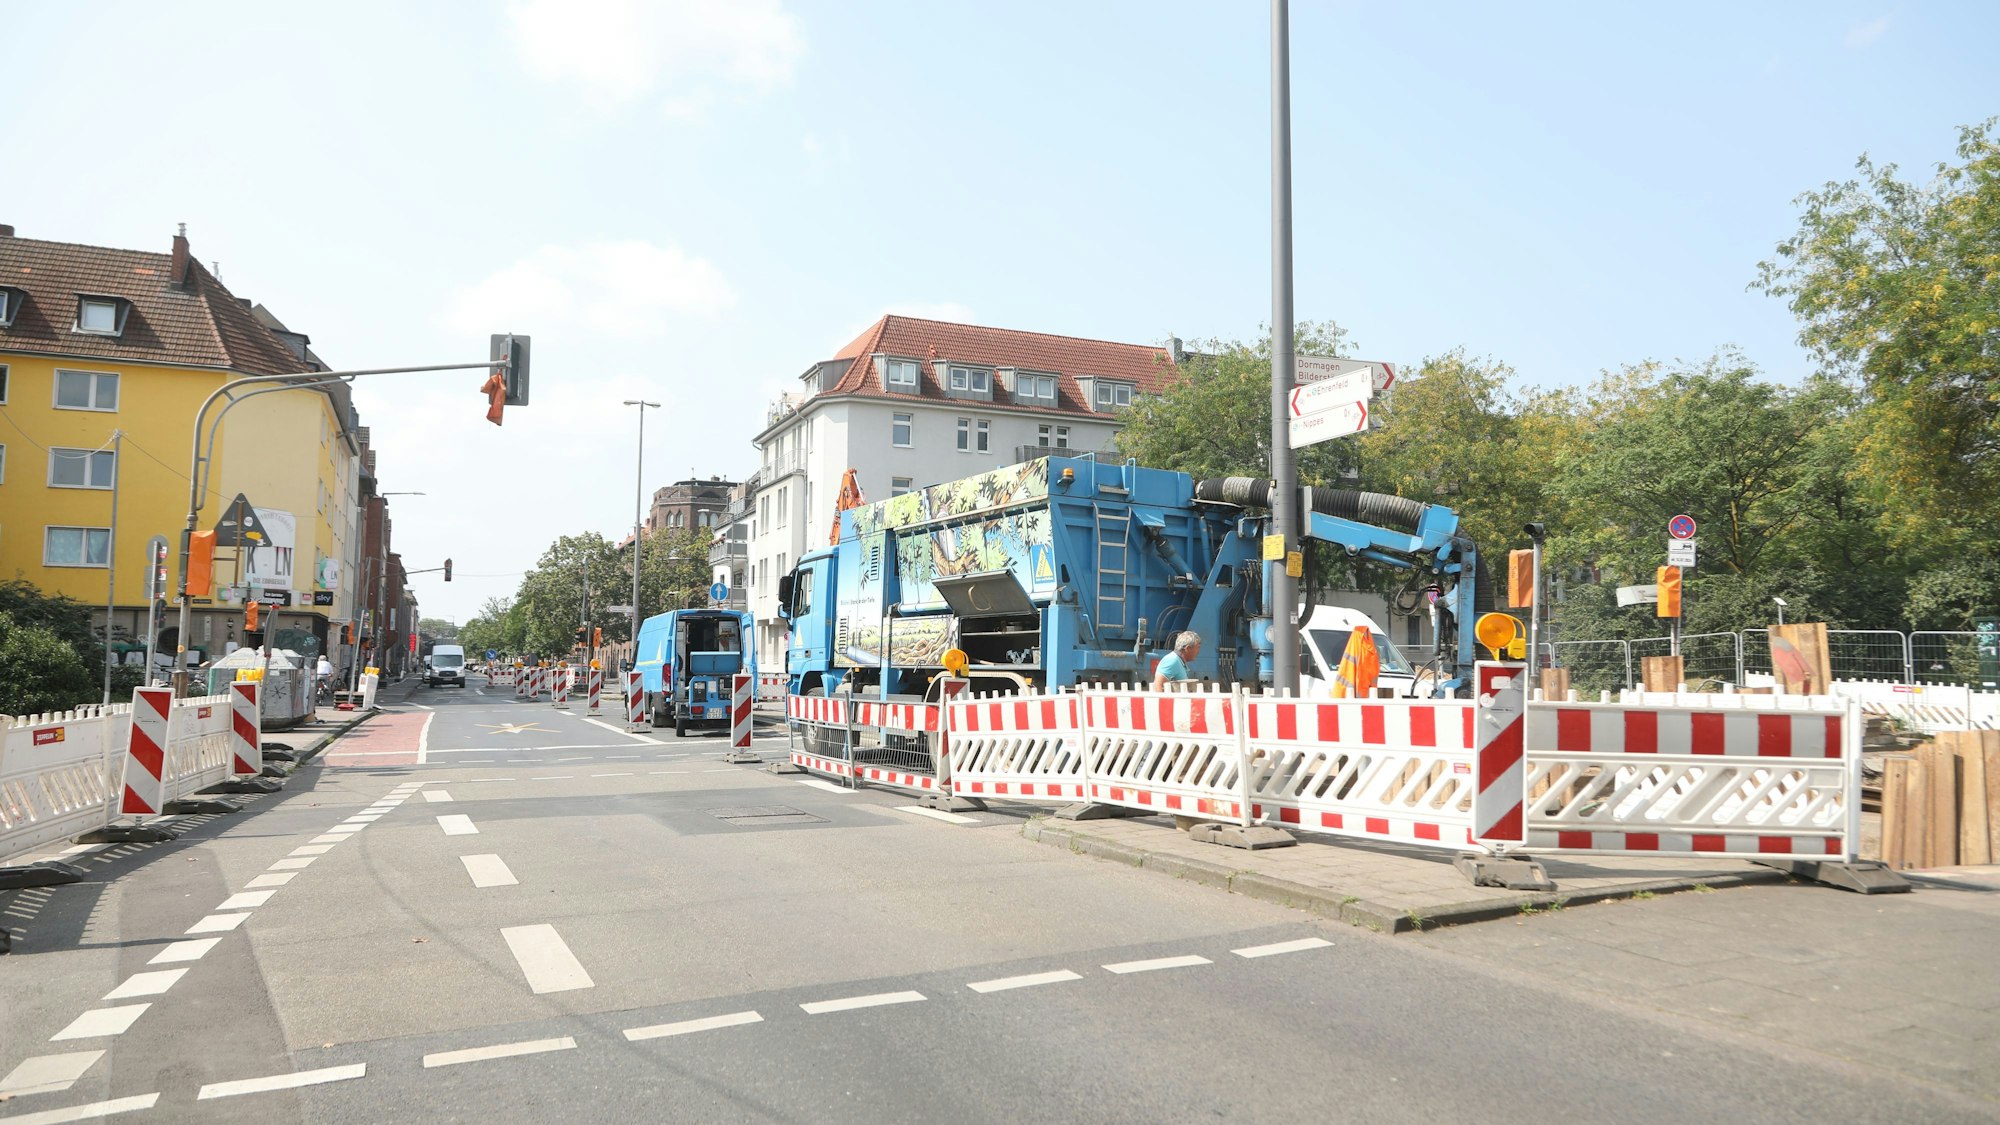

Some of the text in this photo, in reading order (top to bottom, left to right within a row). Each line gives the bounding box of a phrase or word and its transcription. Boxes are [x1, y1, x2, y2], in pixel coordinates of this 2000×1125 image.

[1298, 359, 1340, 372] Dormagen
[1317, 379, 1349, 395] Ehrenfeld
[1303, 418, 1324, 428] Nippes
[316, 594, 332, 602] sky
[36, 733, 55, 741] ZEPPELIN
